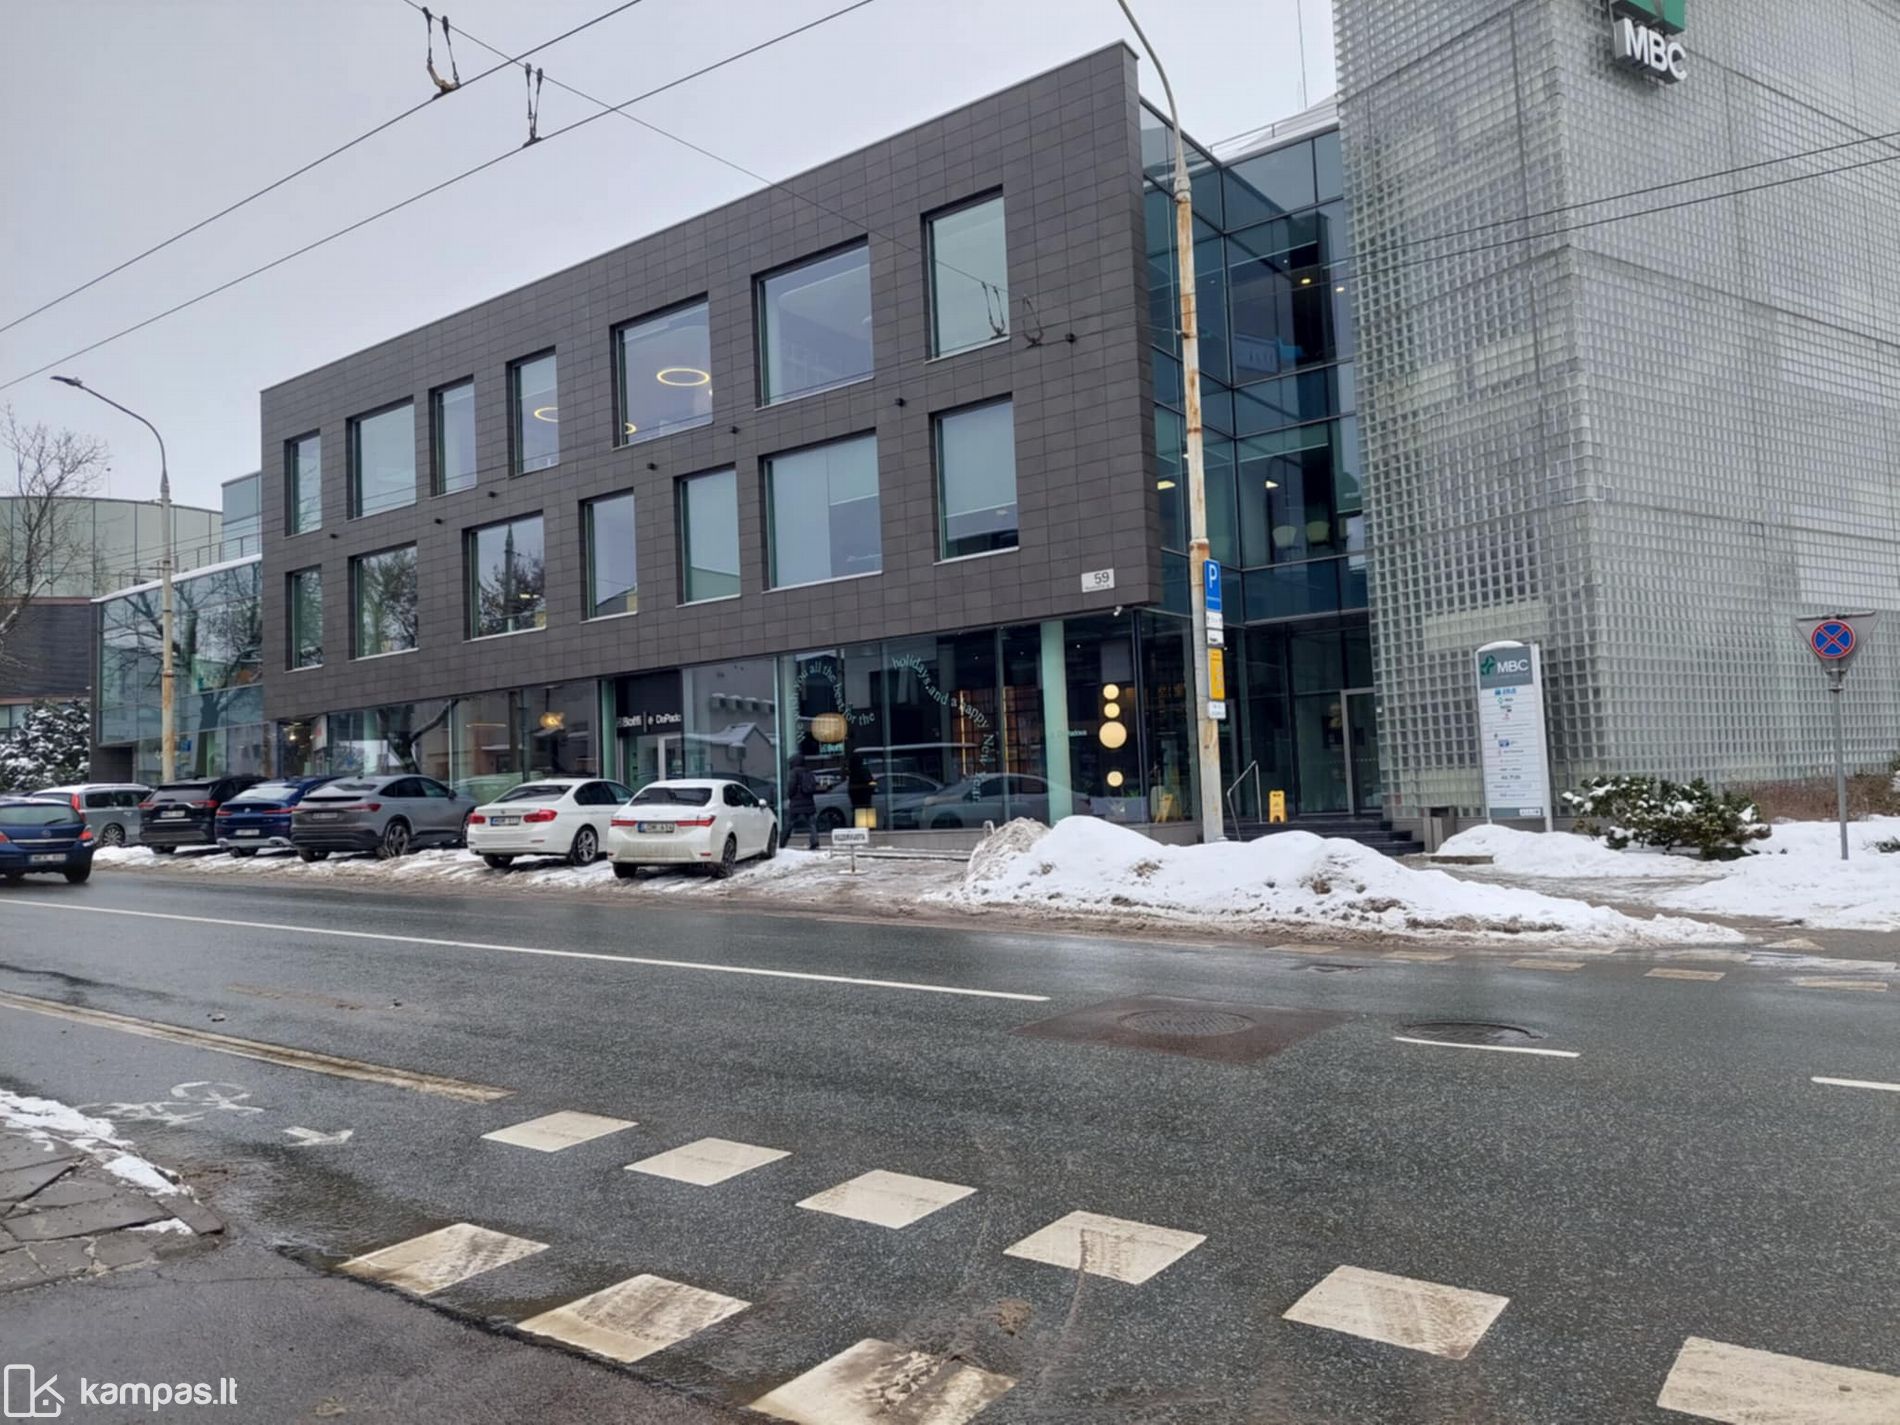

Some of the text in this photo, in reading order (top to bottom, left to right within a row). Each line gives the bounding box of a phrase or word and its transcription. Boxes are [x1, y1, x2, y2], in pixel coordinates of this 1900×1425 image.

[1623, 17, 1687, 79] MBC
[1094, 571, 1110, 584] 59
[1209, 564, 1217, 589] P
[1497, 659, 1529, 673] MBC
[793, 670, 809, 691] you
[809, 661, 822, 674] all
[822, 665, 837, 682] the
[833, 682, 846, 713] best
[859, 712, 875, 726] the
[928, 686, 950, 705] and
[950, 697, 957, 707] a
[959, 699, 990, 729] happy
[979, 733, 996, 766] New
